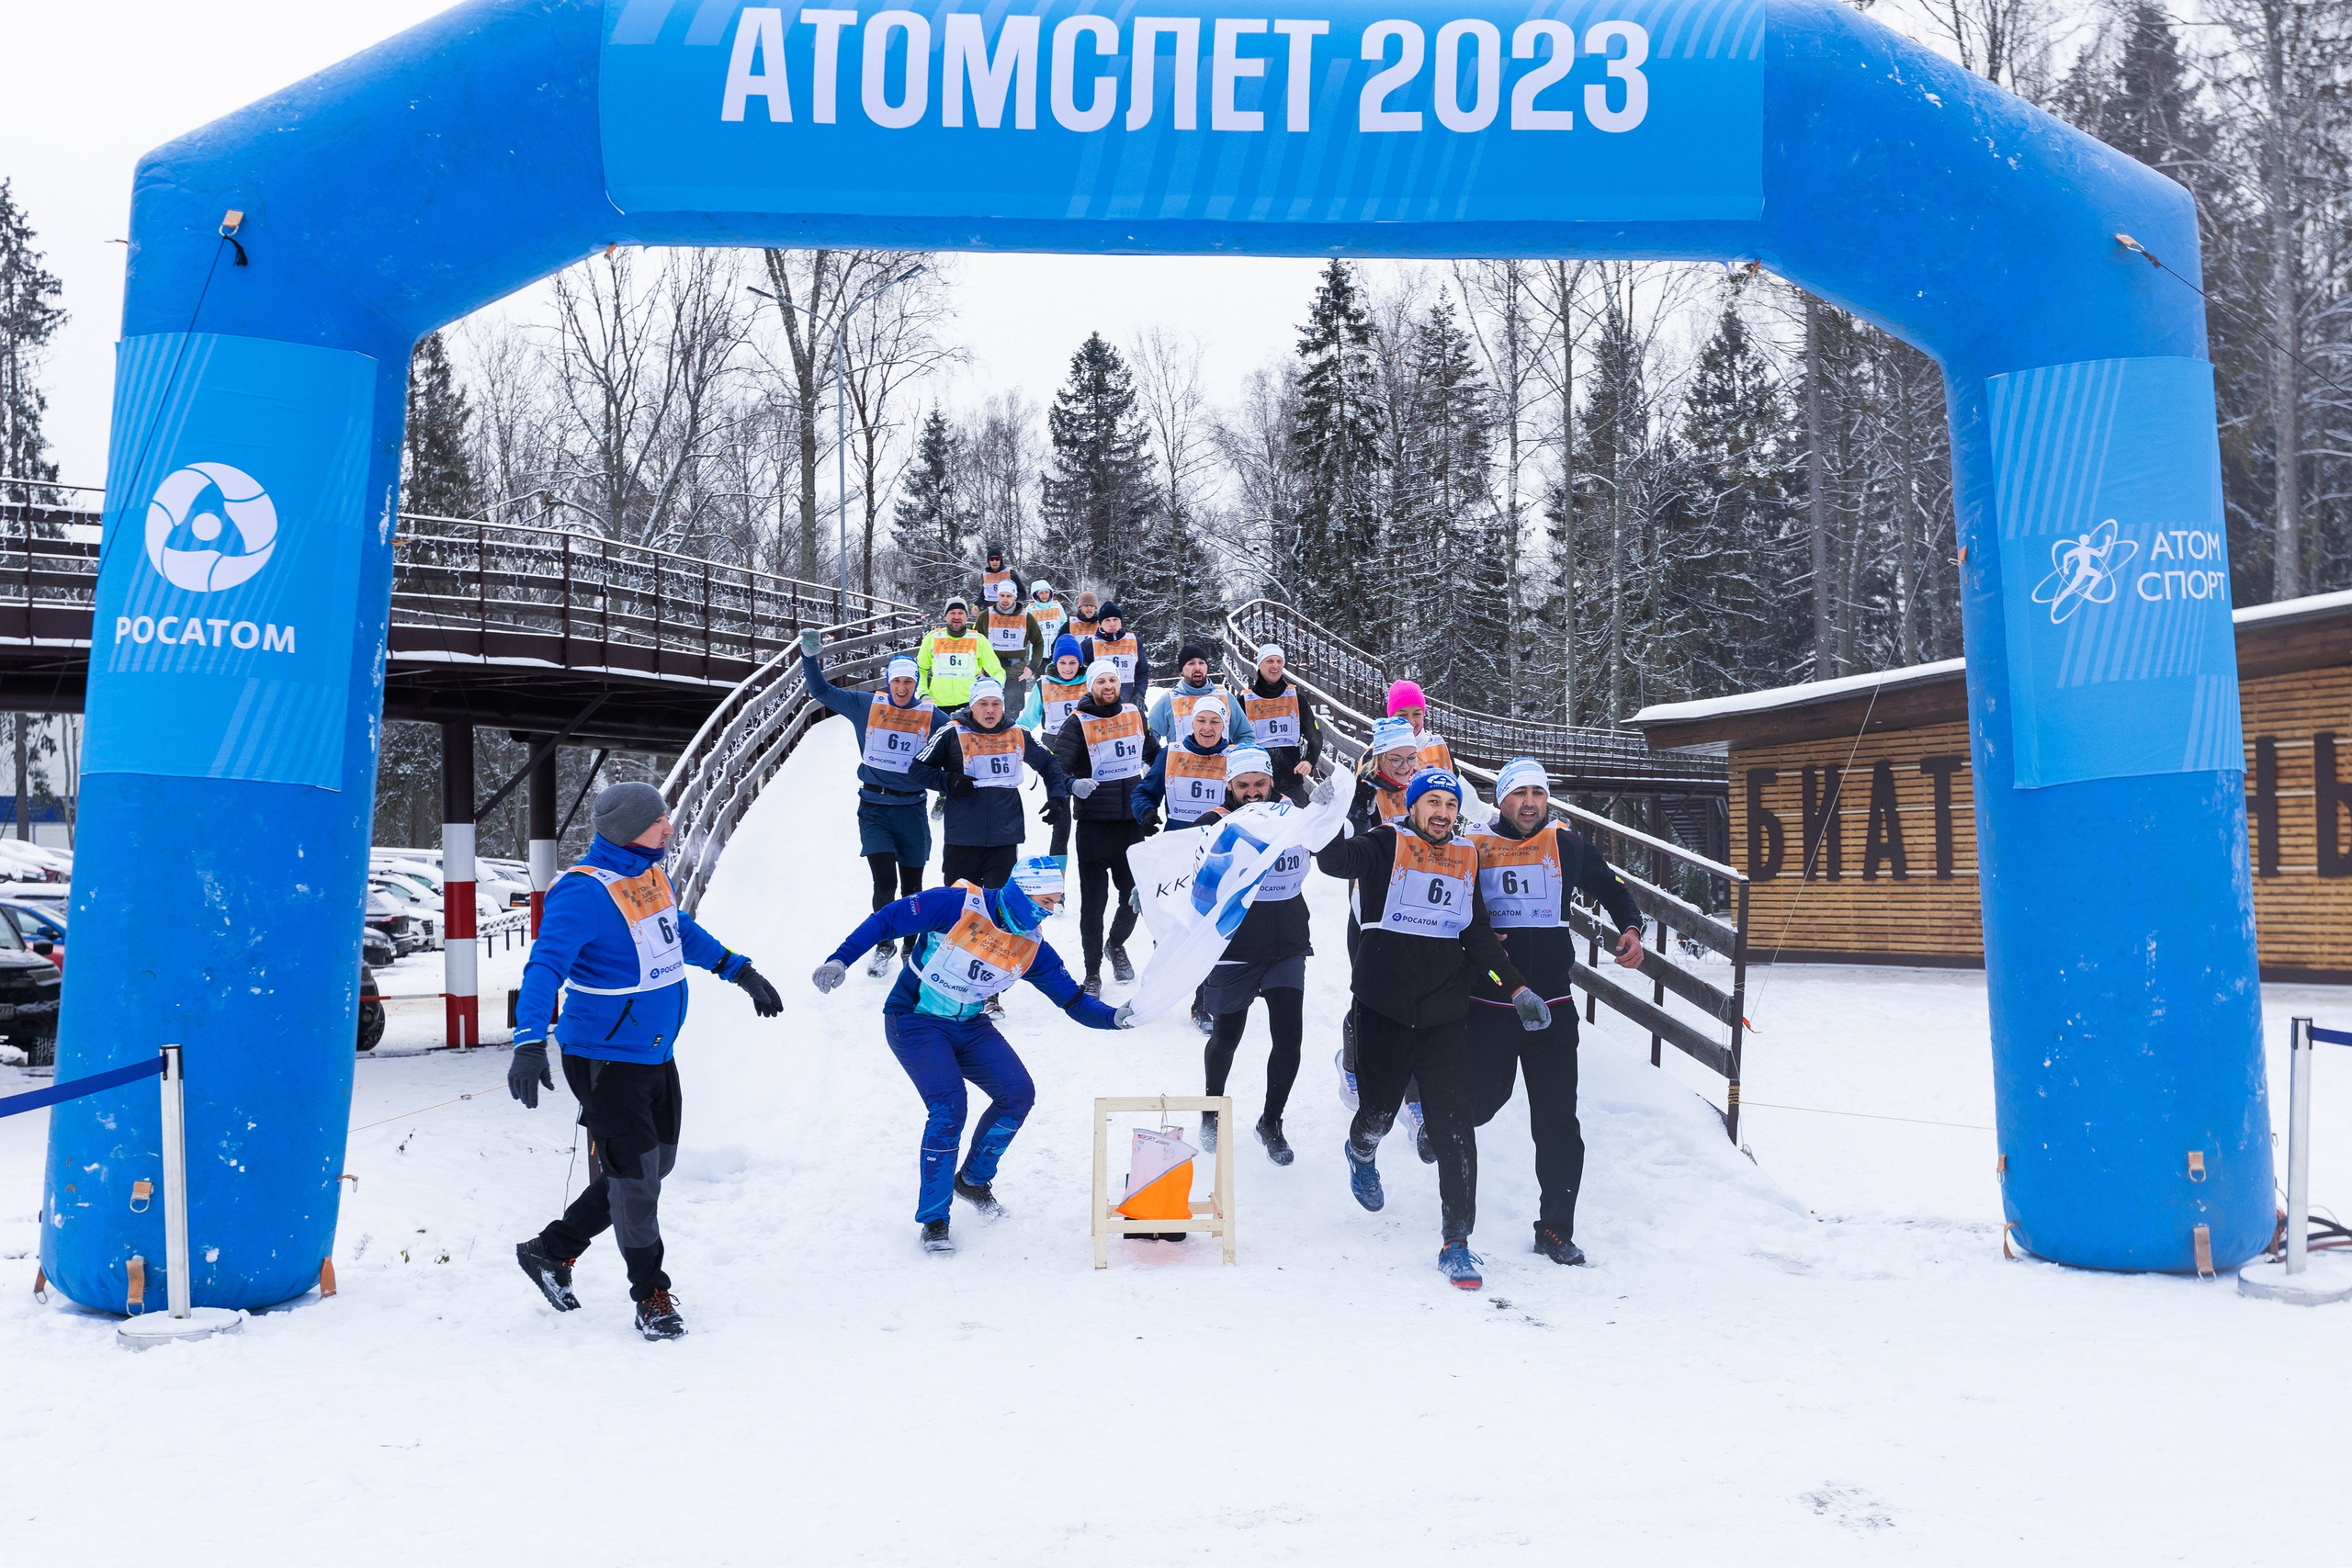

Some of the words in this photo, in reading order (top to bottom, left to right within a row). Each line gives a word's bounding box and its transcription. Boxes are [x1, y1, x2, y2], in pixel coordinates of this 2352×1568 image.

[721, 8, 1329, 132] АТОМСЛЕТ
[1360, 17, 1648, 132] 2023
[2151, 530, 2222, 561] АТОМ
[2137, 570, 2225, 601] СПОРТ
[115, 615, 295, 653] РОСАТОМ
[1269, 720, 1277, 734] 6
[888, 733, 899, 750] 6
[900, 741, 910, 751] 12
[1114, 740, 1125, 757] 6
[1126, 744, 1136, 756] 14
[1191, 781, 1203, 798] 6
[1205, 788, 1216, 799] 11
[1287, 855, 1299, 870] 20
[1428, 878, 1443, 904] 6
[1443, 891, 1452, 906] 2
[1502, 870, 1519, 895] 6
[1521, 879, 1529, 894] 1
[658, 917, 674, 944] 6
[1402, 915, 1438, 926] РОСАТОМ
[967, 959, 984, 980] 6
